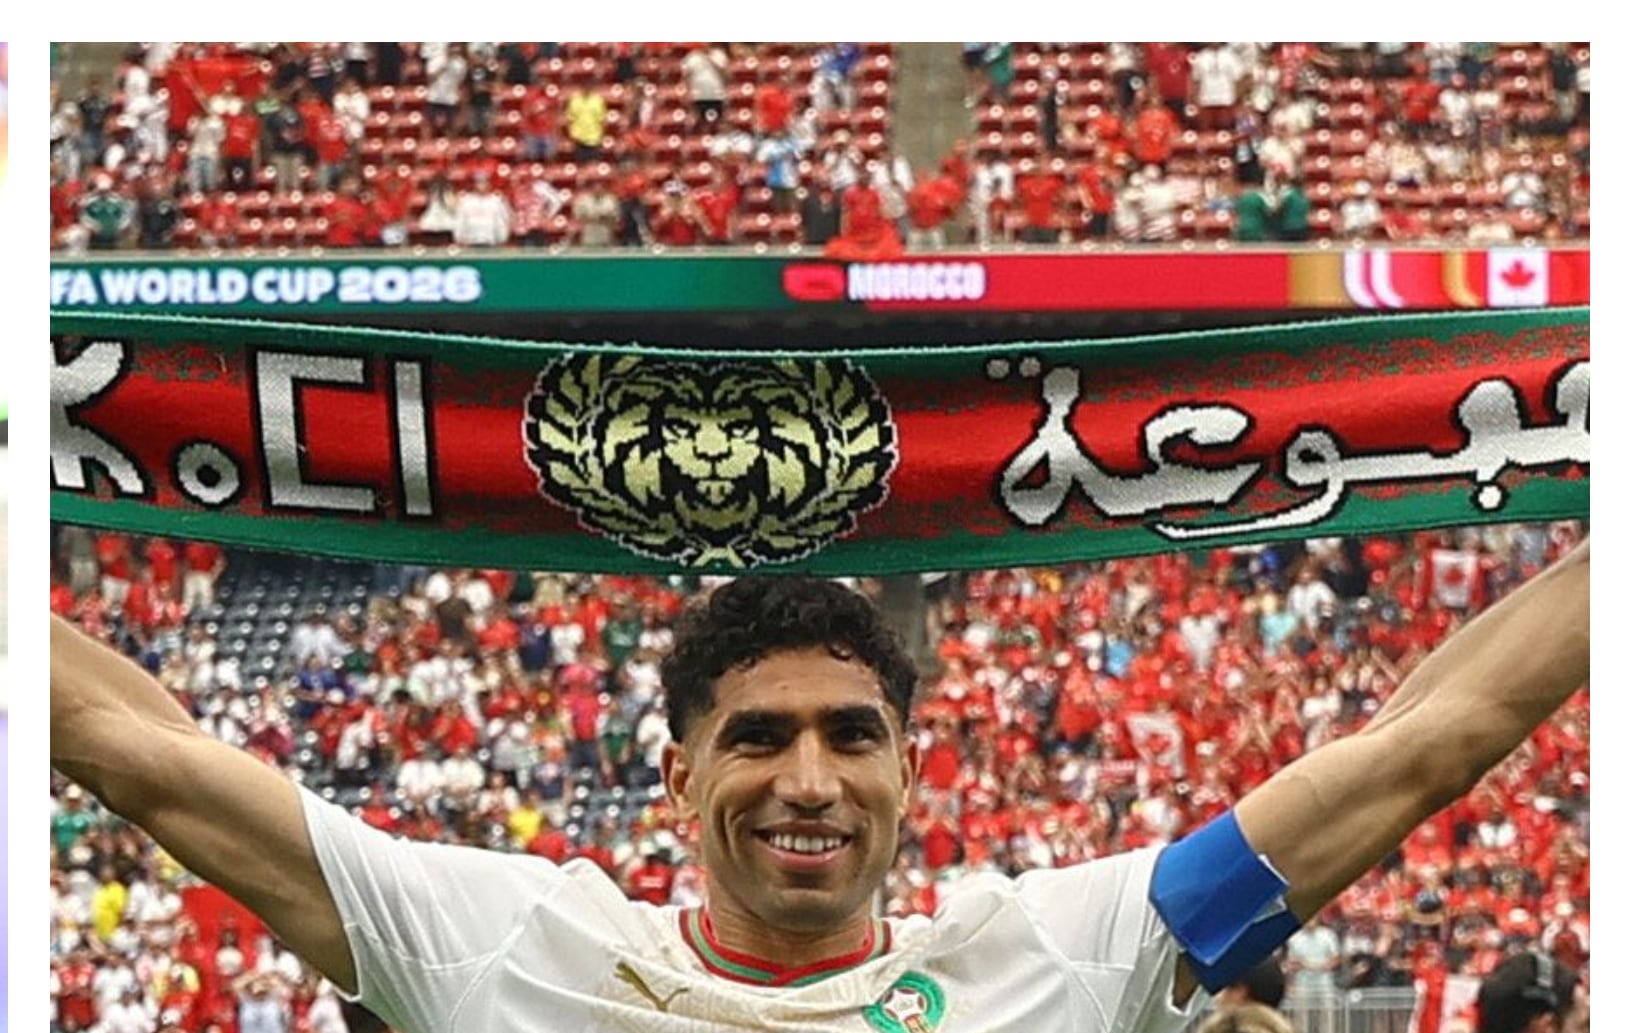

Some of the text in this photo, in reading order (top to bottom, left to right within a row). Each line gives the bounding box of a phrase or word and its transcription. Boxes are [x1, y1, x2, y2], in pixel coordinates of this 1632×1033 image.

[100, 267, 248, 304] WORLD
[252, 266, 335, 304] CUP
[337, 265, 482, 303] 2026
